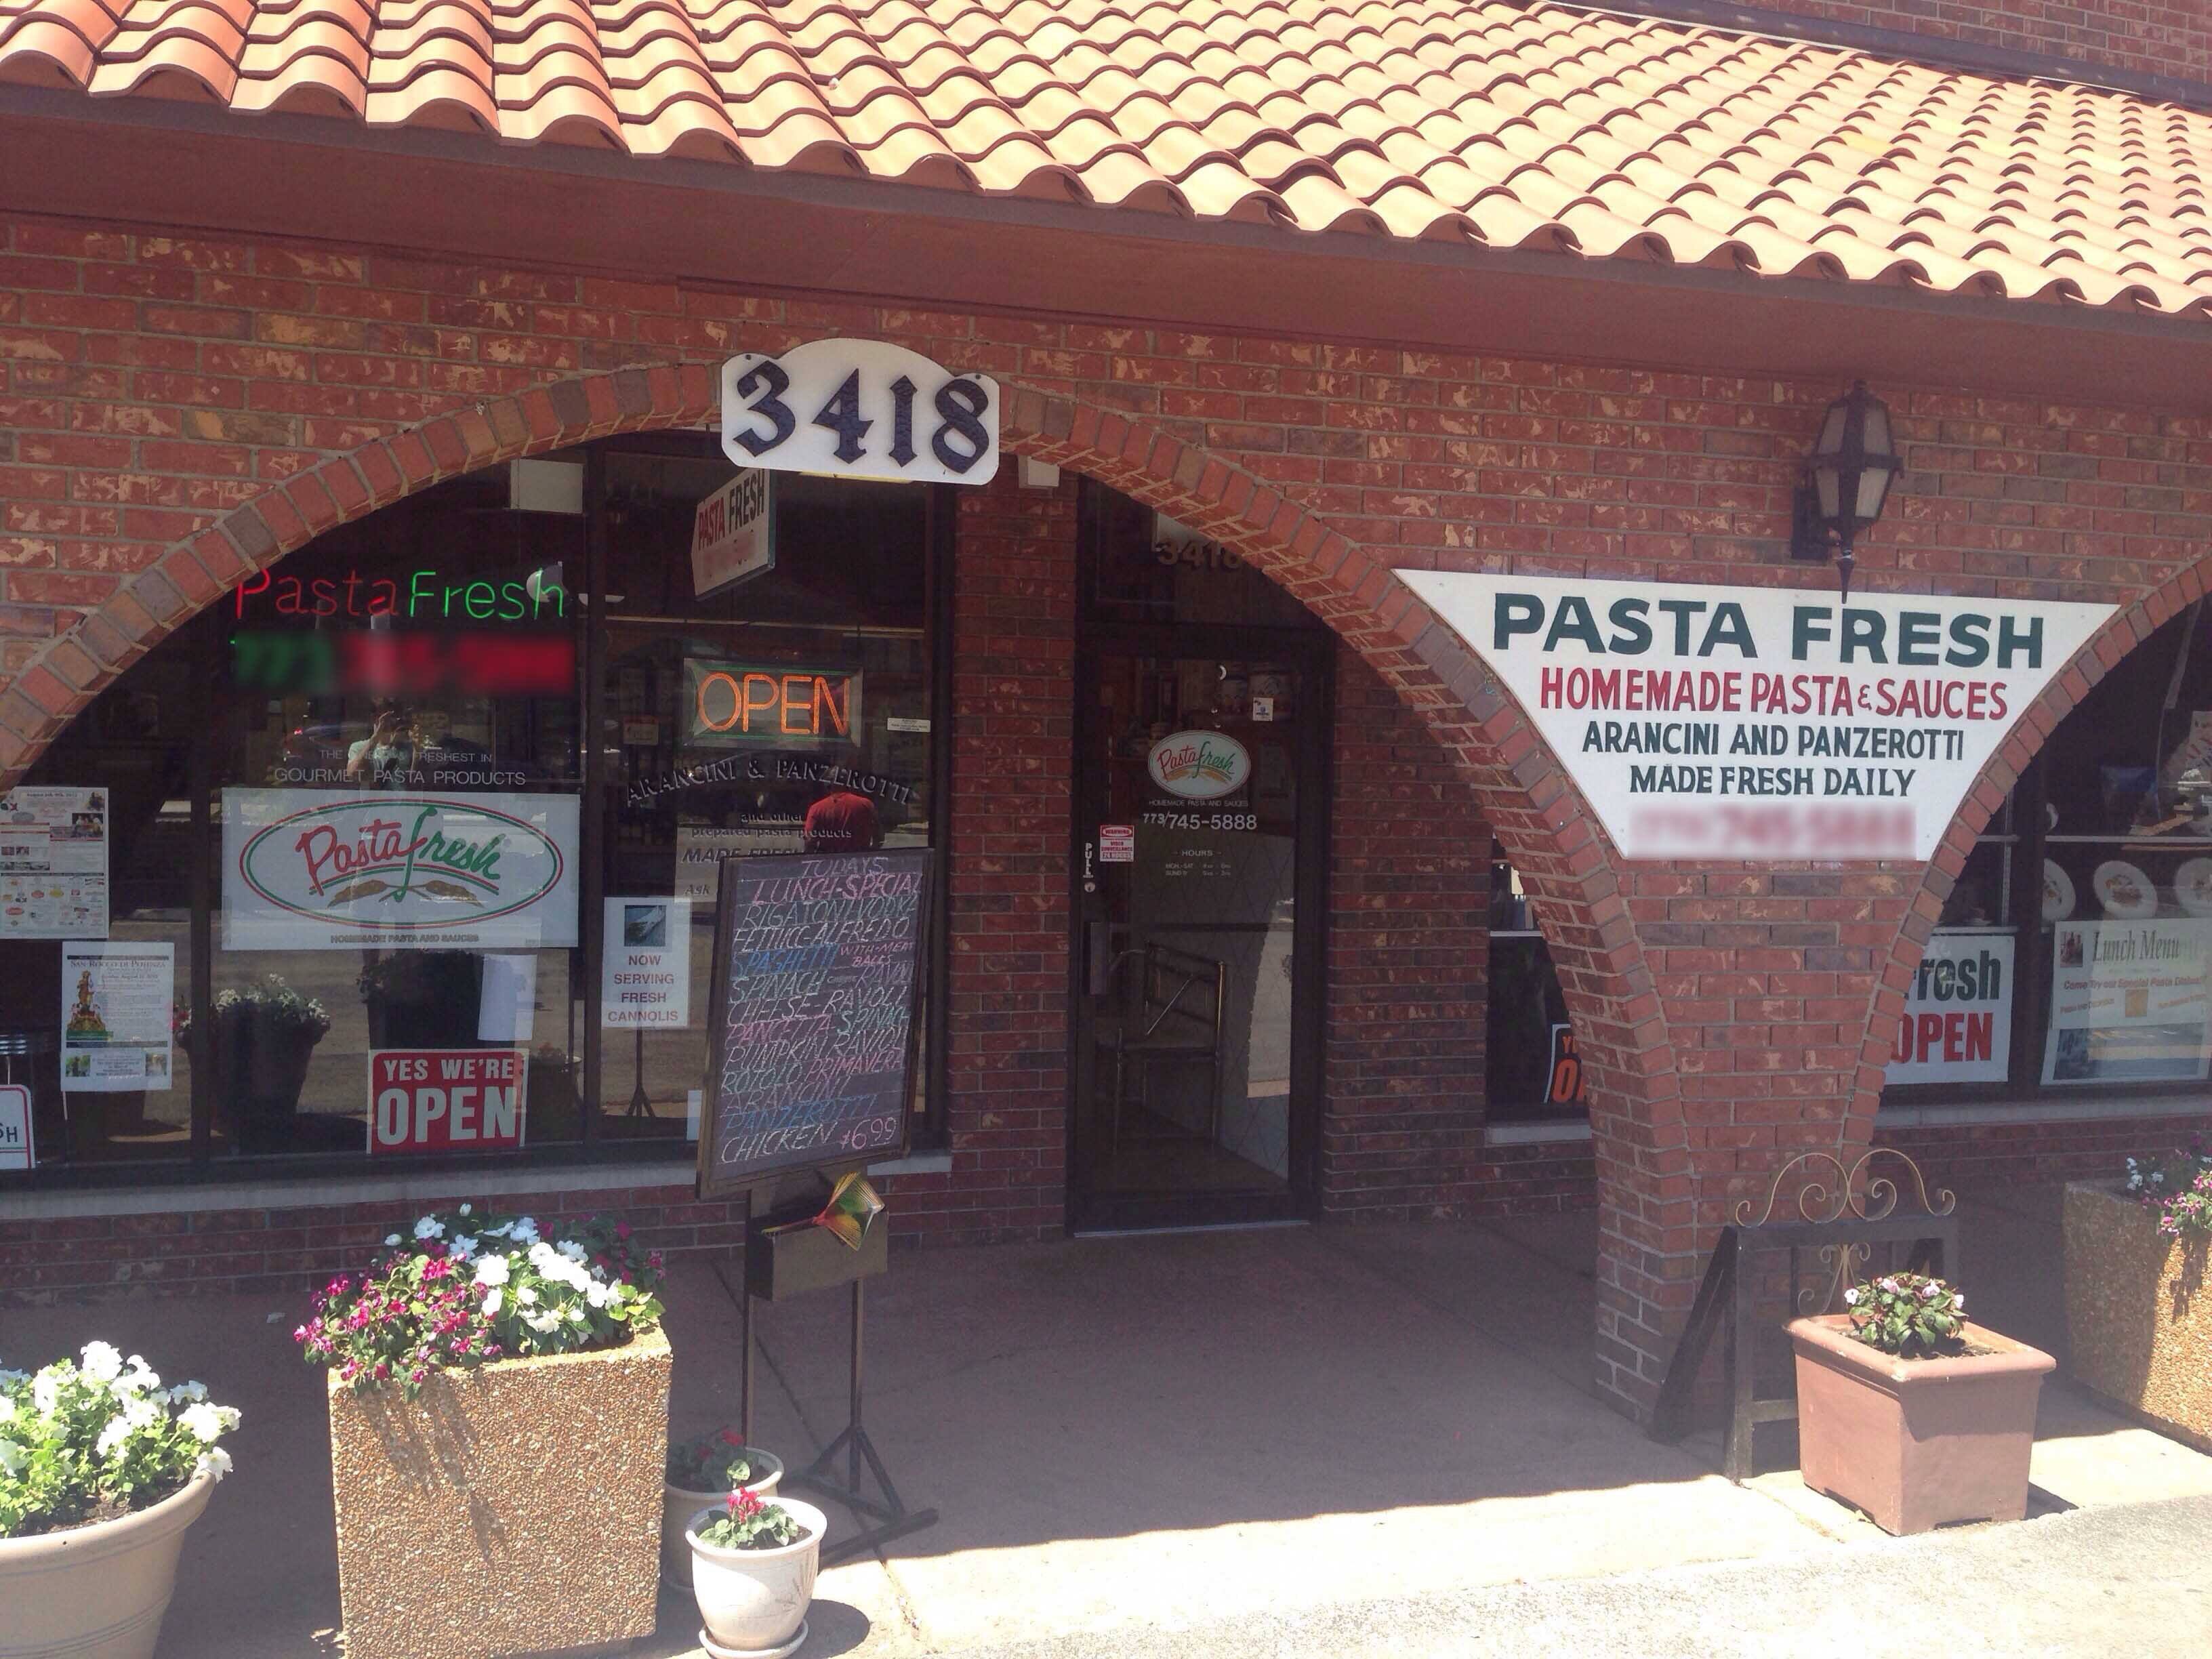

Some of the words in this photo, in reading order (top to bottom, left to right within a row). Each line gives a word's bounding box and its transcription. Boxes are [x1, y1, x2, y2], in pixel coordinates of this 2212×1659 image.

[733, 360, 989, 474] 3418
[699, 497, 725, 551] PASTA
[729, 469, 765, 534] FRESH
[1494, 592, 1759, 659] PASTA
[1790, 606, 2044, 669] FRESH
[698, 672, 850, 735] OPEN
[1540, 668, 1740, 712] HOMEMADE
[1582, 720, 1719, 755] ARANCINI
[1729, 722, 1788, 756] AND
[1797, 725, 1963, 761] PANZEROTTI
[319, 750, 342, 760] THE
[480, 753, 492, 763] IN
[274, 767, 365, 782] GOURMET
[373, 768, 425, 783] PASTA
[433, 769, 526, 785] PRODUCTS
[628, 758, 737, 807] ARANCINI
[747, 759, 765, 779] &
[777, 759, 909, 805] PANZEROTTI
[1629, 764, 1712, 796] MADE
[1720, 766, 1814, 796] FRESH
[1824, 768, 1917, 798] DAILY
[741, 811, 764, 823] and
[691, 828, 751, 839] prepared
[757, 828, 792, 839] pasta
[802, 857, 888, 879] TODAYS
[685, 884, 710, 895] Ask
[388, 935, 418, 943] PASTA
[419, 935, 440, 943] AND
[2093, 930, 2135, 961] Lunch
[2139, 930, 2179, 960] Menu
[628, 955, 661, 965] NOW
[1904, 950, 2001, 1001] resh
[614, 974, 675, 985] SERVING
[731, 970, 828, 1004] SPINACH
[621, 992, 666, 1003] FRESH
[608, 1010, 679, 1023] CANNOLIS
[383, 1059, 428, 1081] YES
[441, 1058, 514, 1080] WE'RE
[377, 1086, 518, 1145] OPEN
[721, 1122, 838, 1163] CHICKEN
